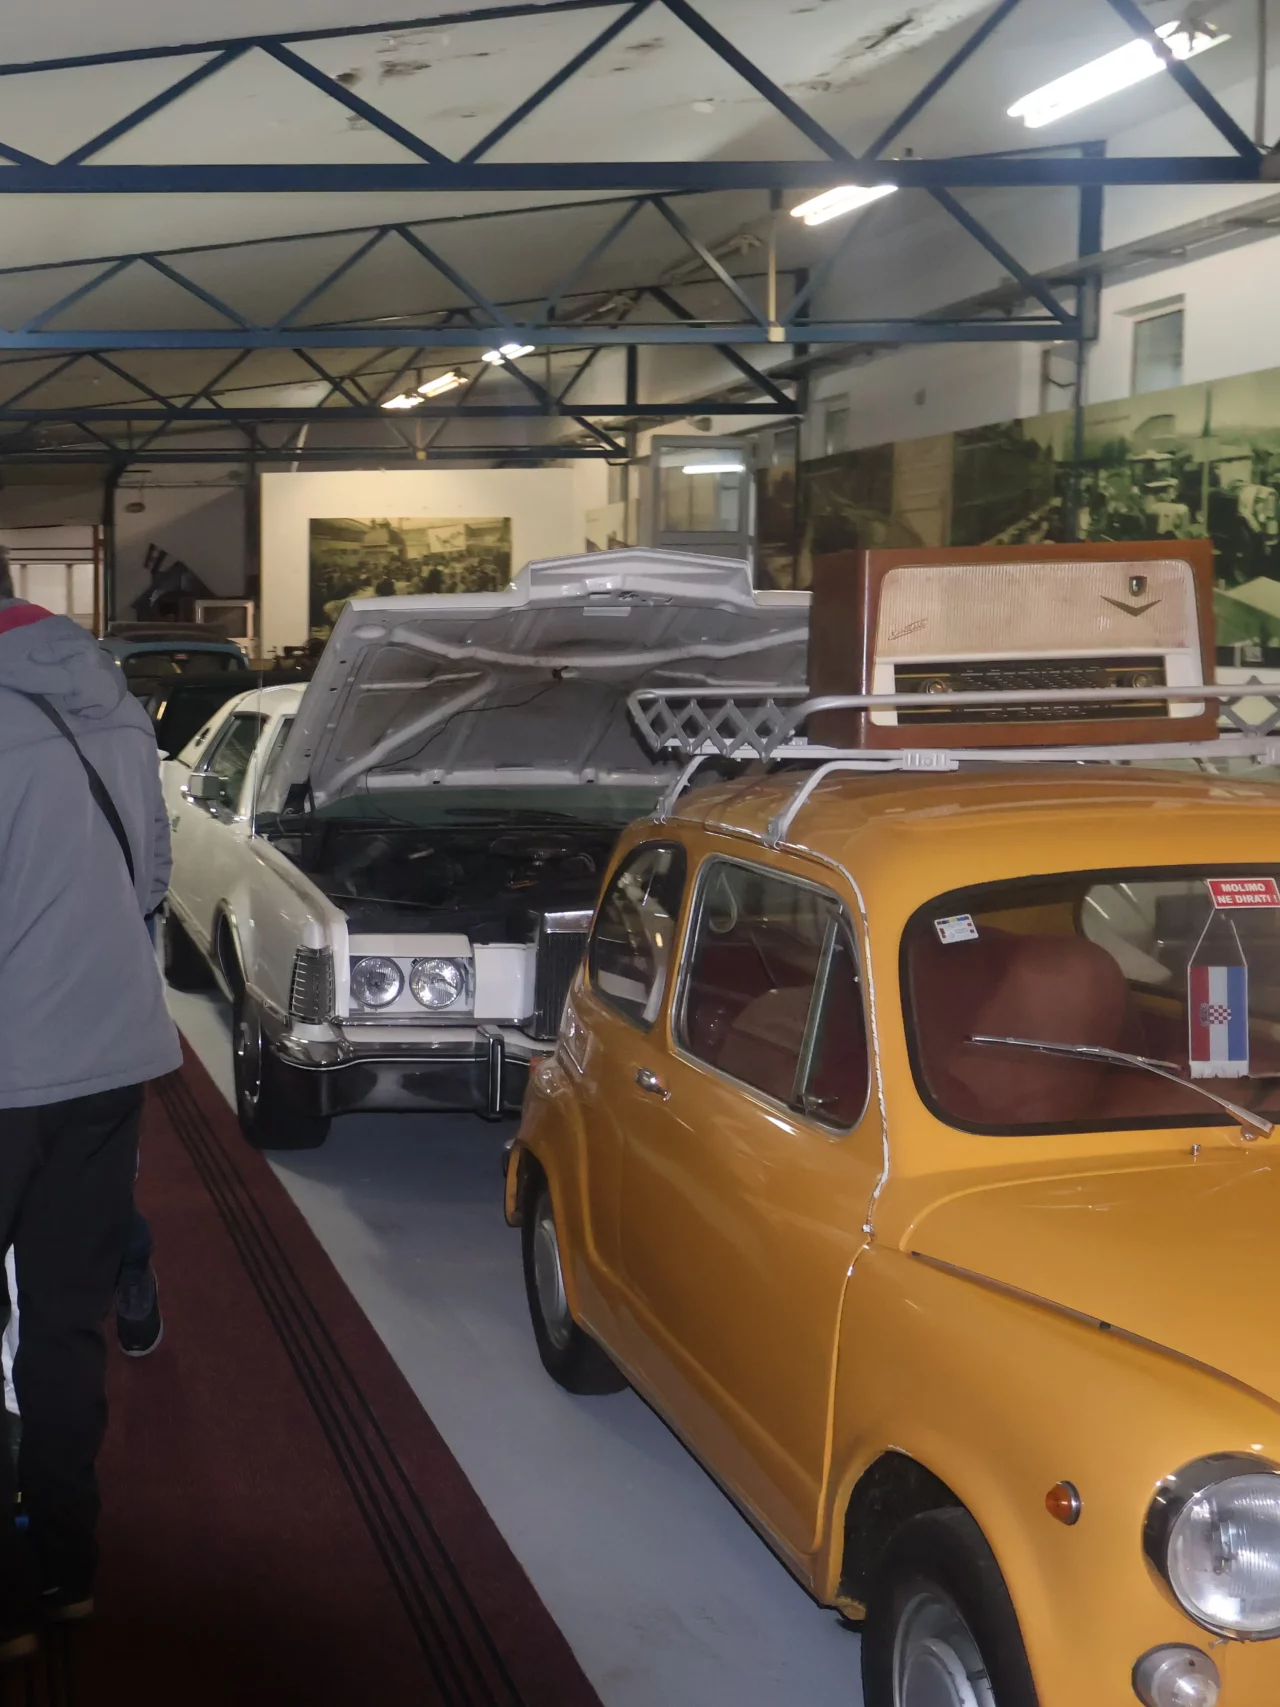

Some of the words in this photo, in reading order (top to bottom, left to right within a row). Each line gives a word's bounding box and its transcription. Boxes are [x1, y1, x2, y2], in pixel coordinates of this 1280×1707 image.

[1220, 883, 1266, 892] MOLIMO
[1217, 895, 1233, 903] NE
[1235, 895, 1271, 903] DIRATI
